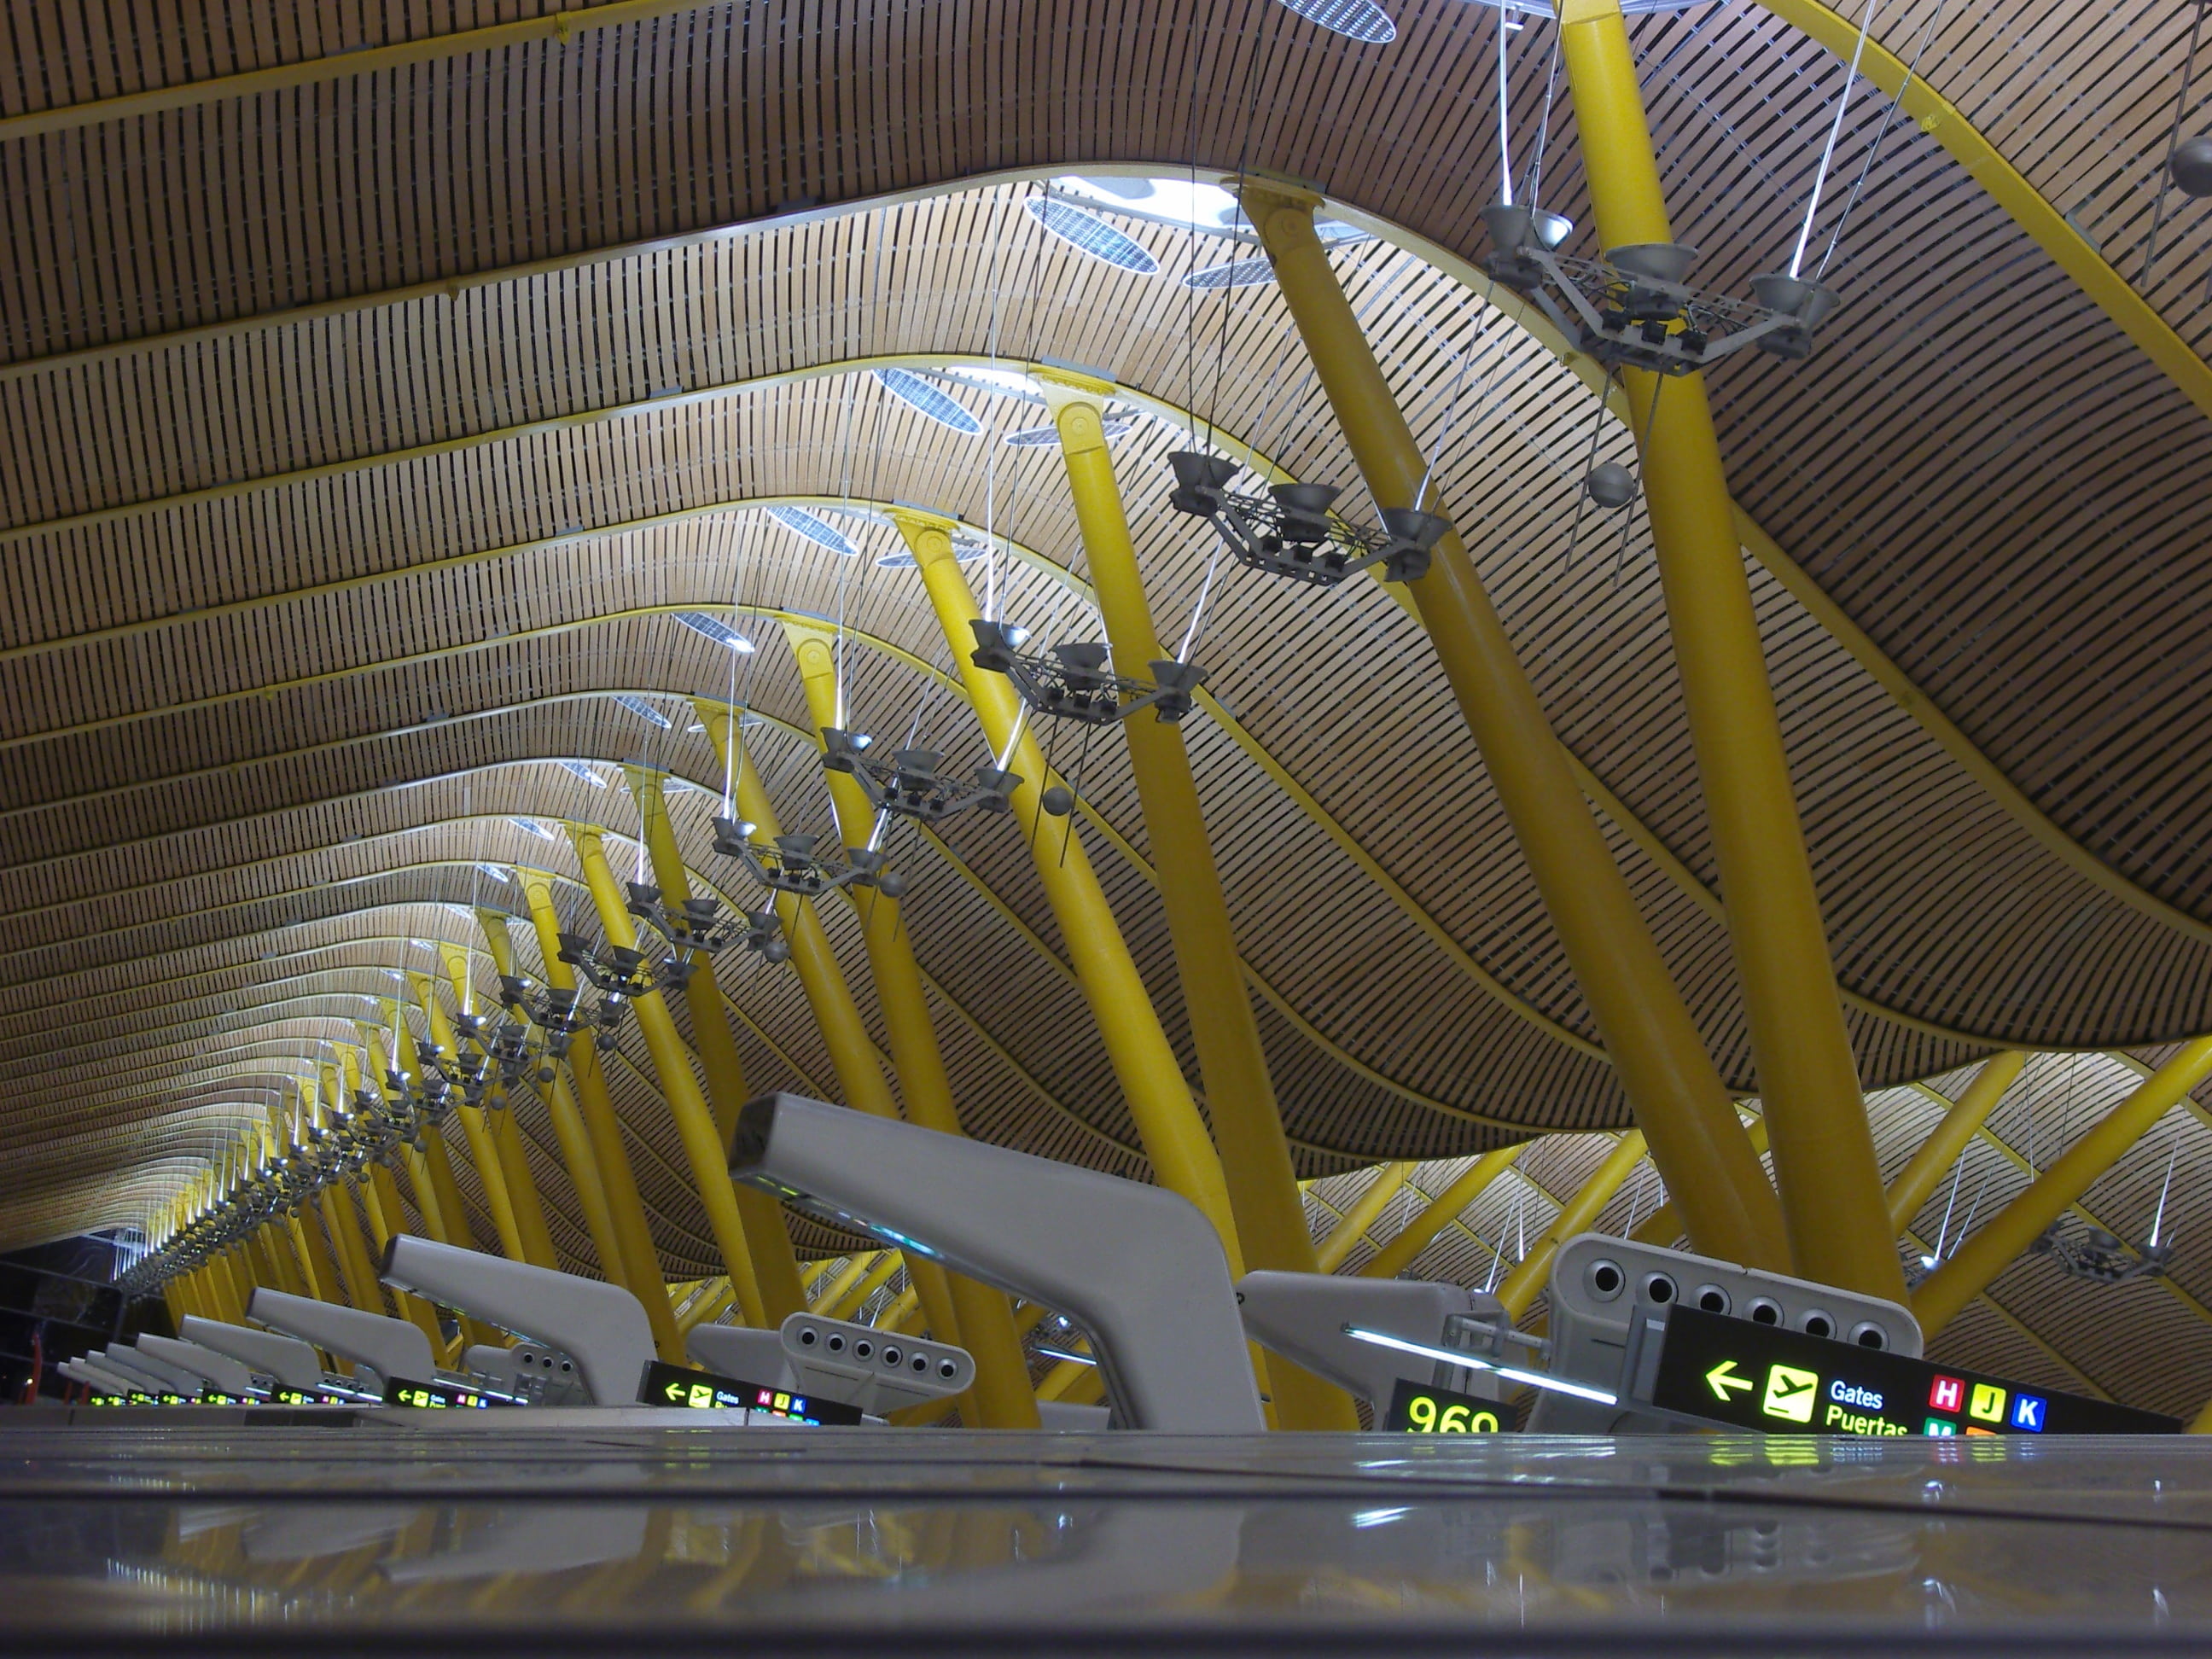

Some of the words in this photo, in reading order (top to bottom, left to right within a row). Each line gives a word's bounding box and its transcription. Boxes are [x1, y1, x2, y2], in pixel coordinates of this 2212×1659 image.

[716, 1391, 739, 1405] Gates
[1831, 1381, 1883, 1409] Gates
[1936, 1380, 1959, 1407] H
[2017, 1398, 2039, 1426] K
[1825, 1405, 1908, 1435] Puertas
